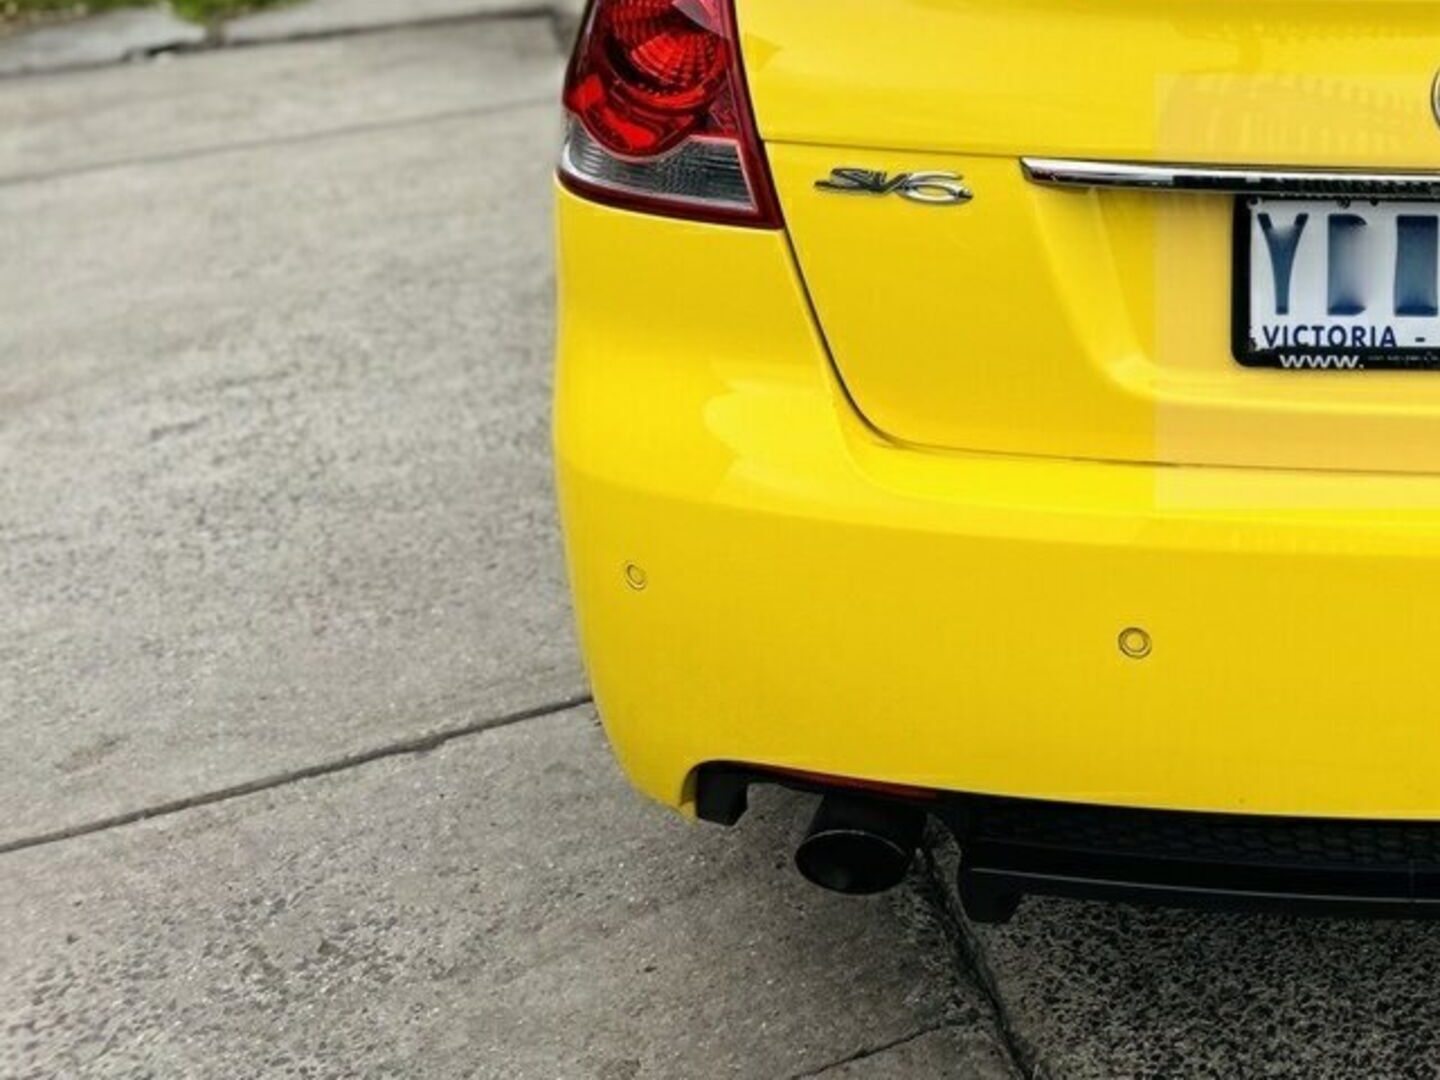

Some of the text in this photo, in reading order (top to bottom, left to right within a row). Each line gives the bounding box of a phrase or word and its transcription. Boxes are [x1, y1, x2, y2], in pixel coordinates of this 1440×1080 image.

[814, 167, 973, 206] SV6
[1262, 325, 1398, 348] VICTORIA
[1278, 353, 1365, 369] www.
